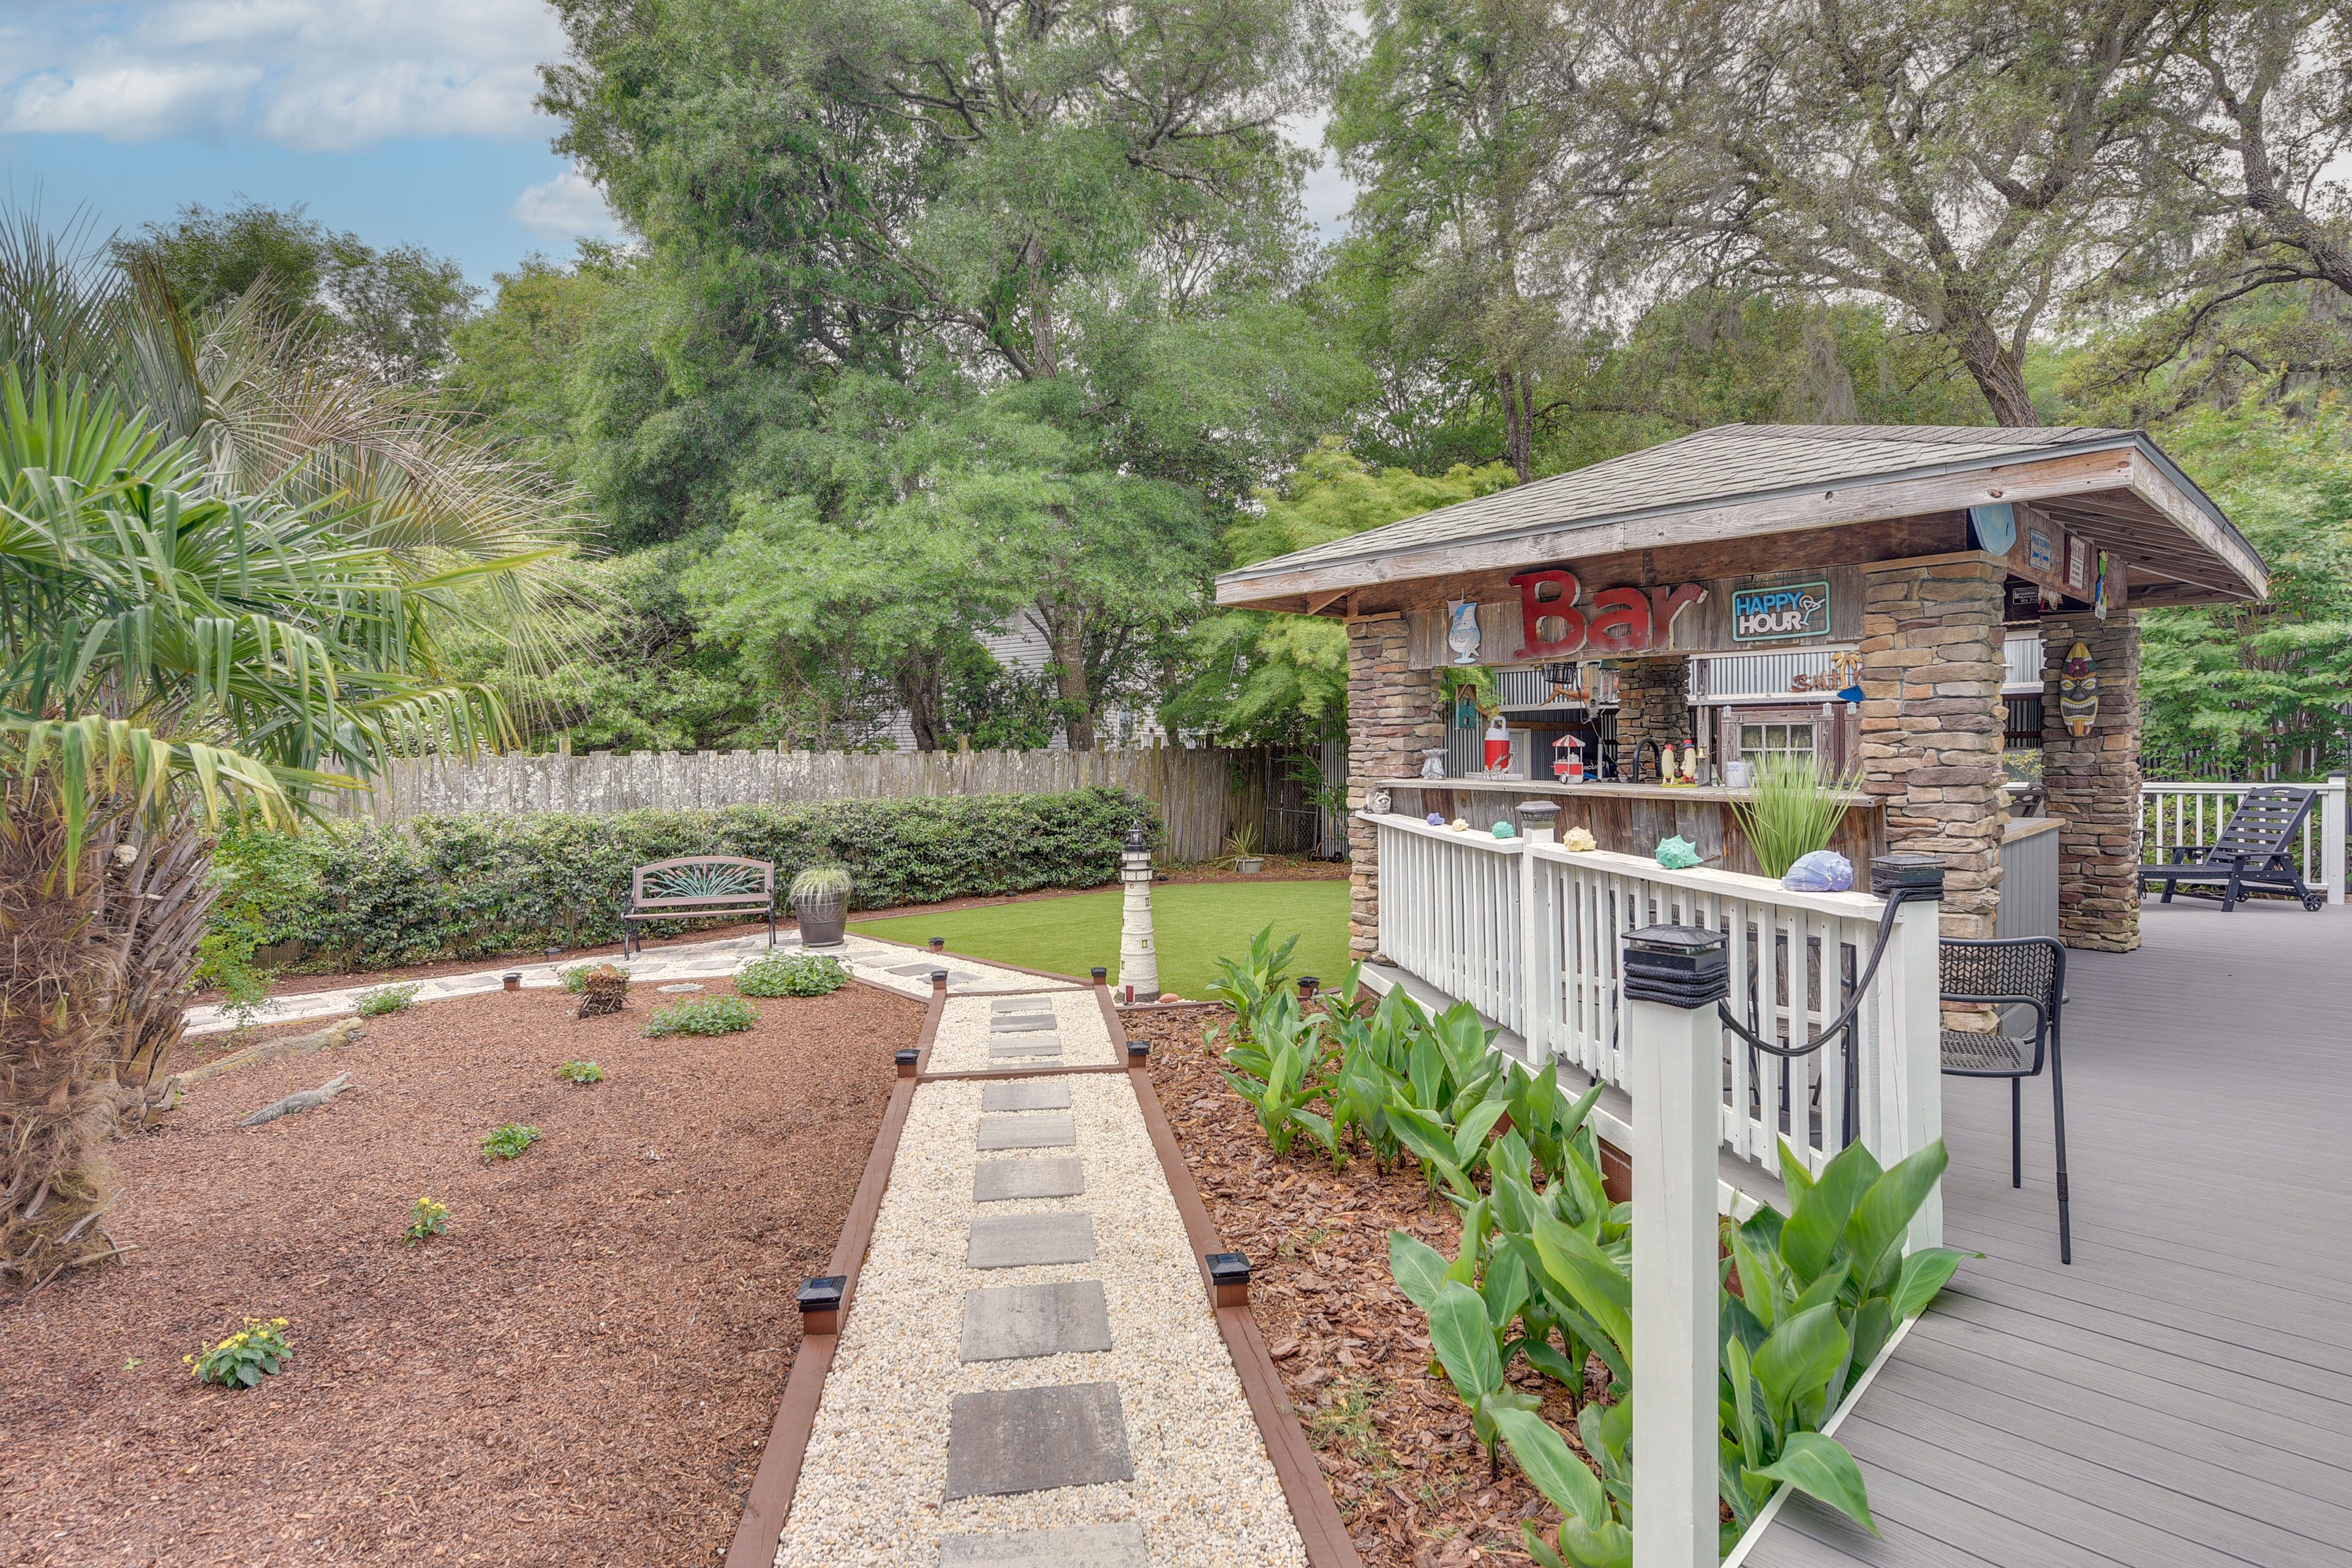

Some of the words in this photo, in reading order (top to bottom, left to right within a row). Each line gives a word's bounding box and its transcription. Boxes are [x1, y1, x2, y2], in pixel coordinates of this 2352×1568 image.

[1509, 570, 1709, 660] Bar
[1736, 590, 1804, 616] HAPPY
[1740, 611, 1801, 635] HOUR
